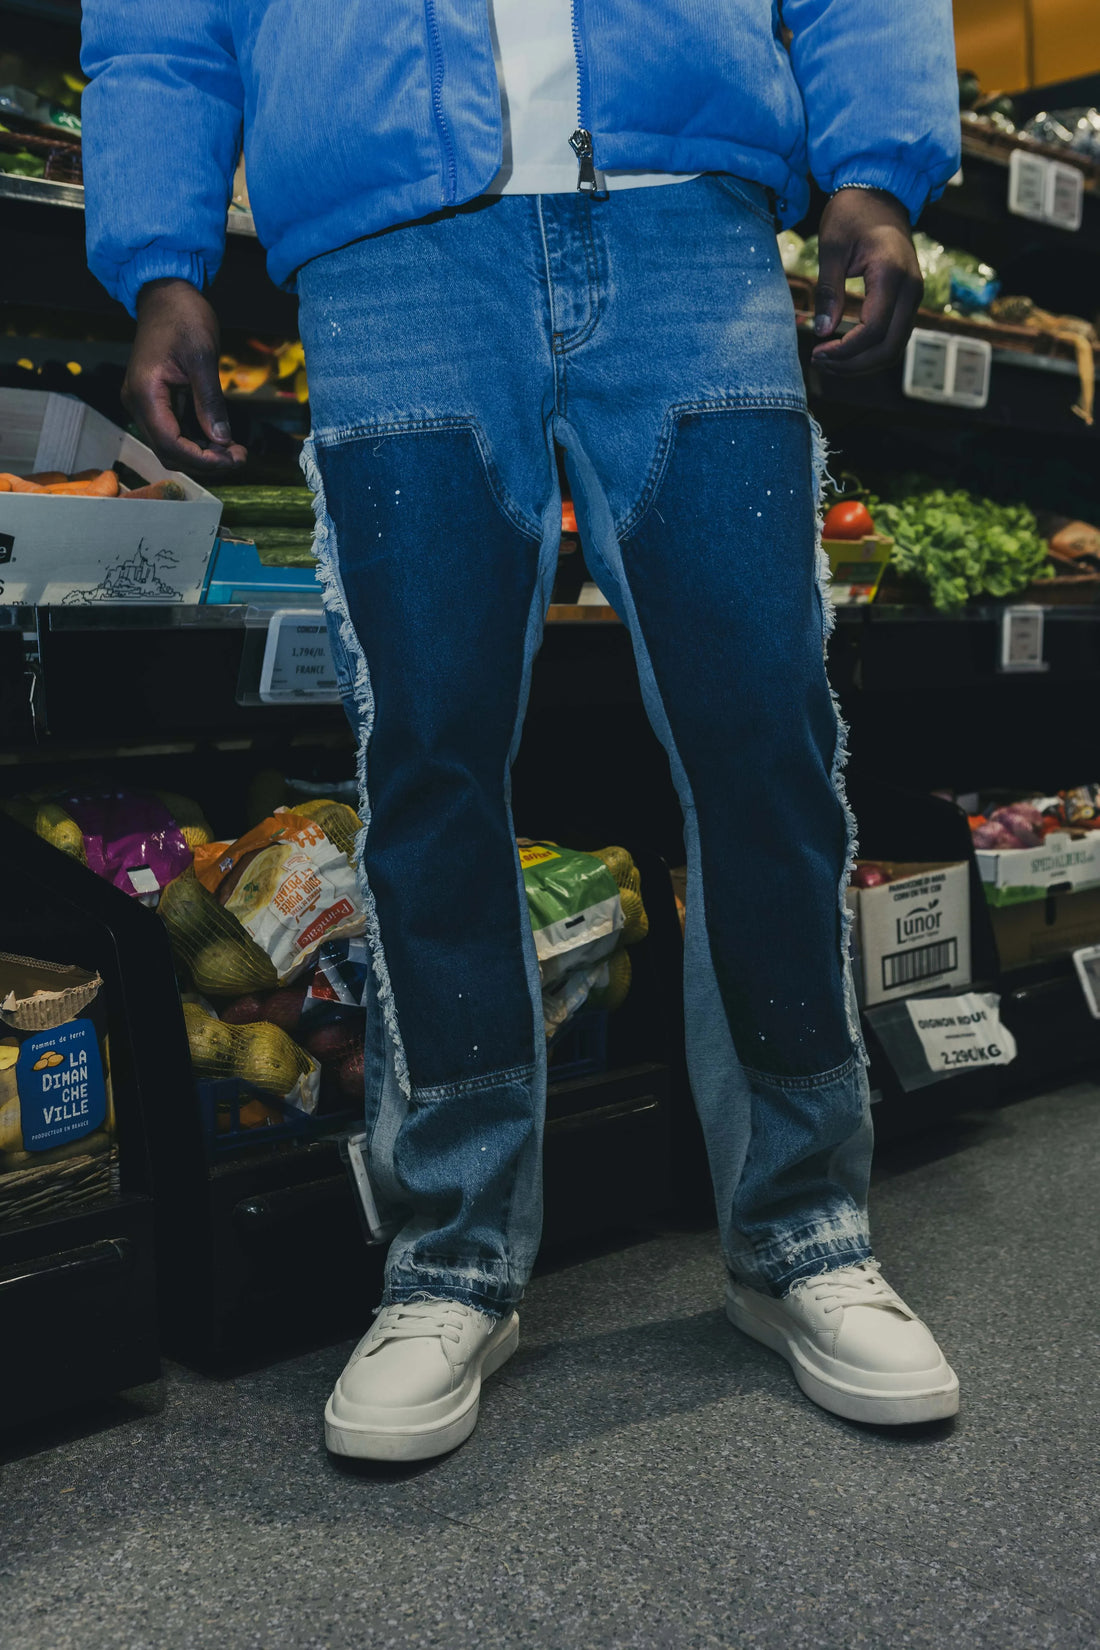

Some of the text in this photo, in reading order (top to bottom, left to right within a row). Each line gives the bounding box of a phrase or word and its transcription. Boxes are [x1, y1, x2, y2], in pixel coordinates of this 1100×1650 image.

[295, 665, 324, 674] FRANCE
[273, 874, 302, 908] POTAGE
[302, 903, 350, 944] Priméale
[896, 911, 942, 944] Lunor
[31, 1039, 56, 1052] Pommes
[70, 1030, 85, 1040] terre
[69, 1049, 87, 1067] LA
[42, 1065, 88, 1092] DIMAN
[62, 1083, 88, 1102] CHE
[43, 1099, 89, 1125] VILLE
